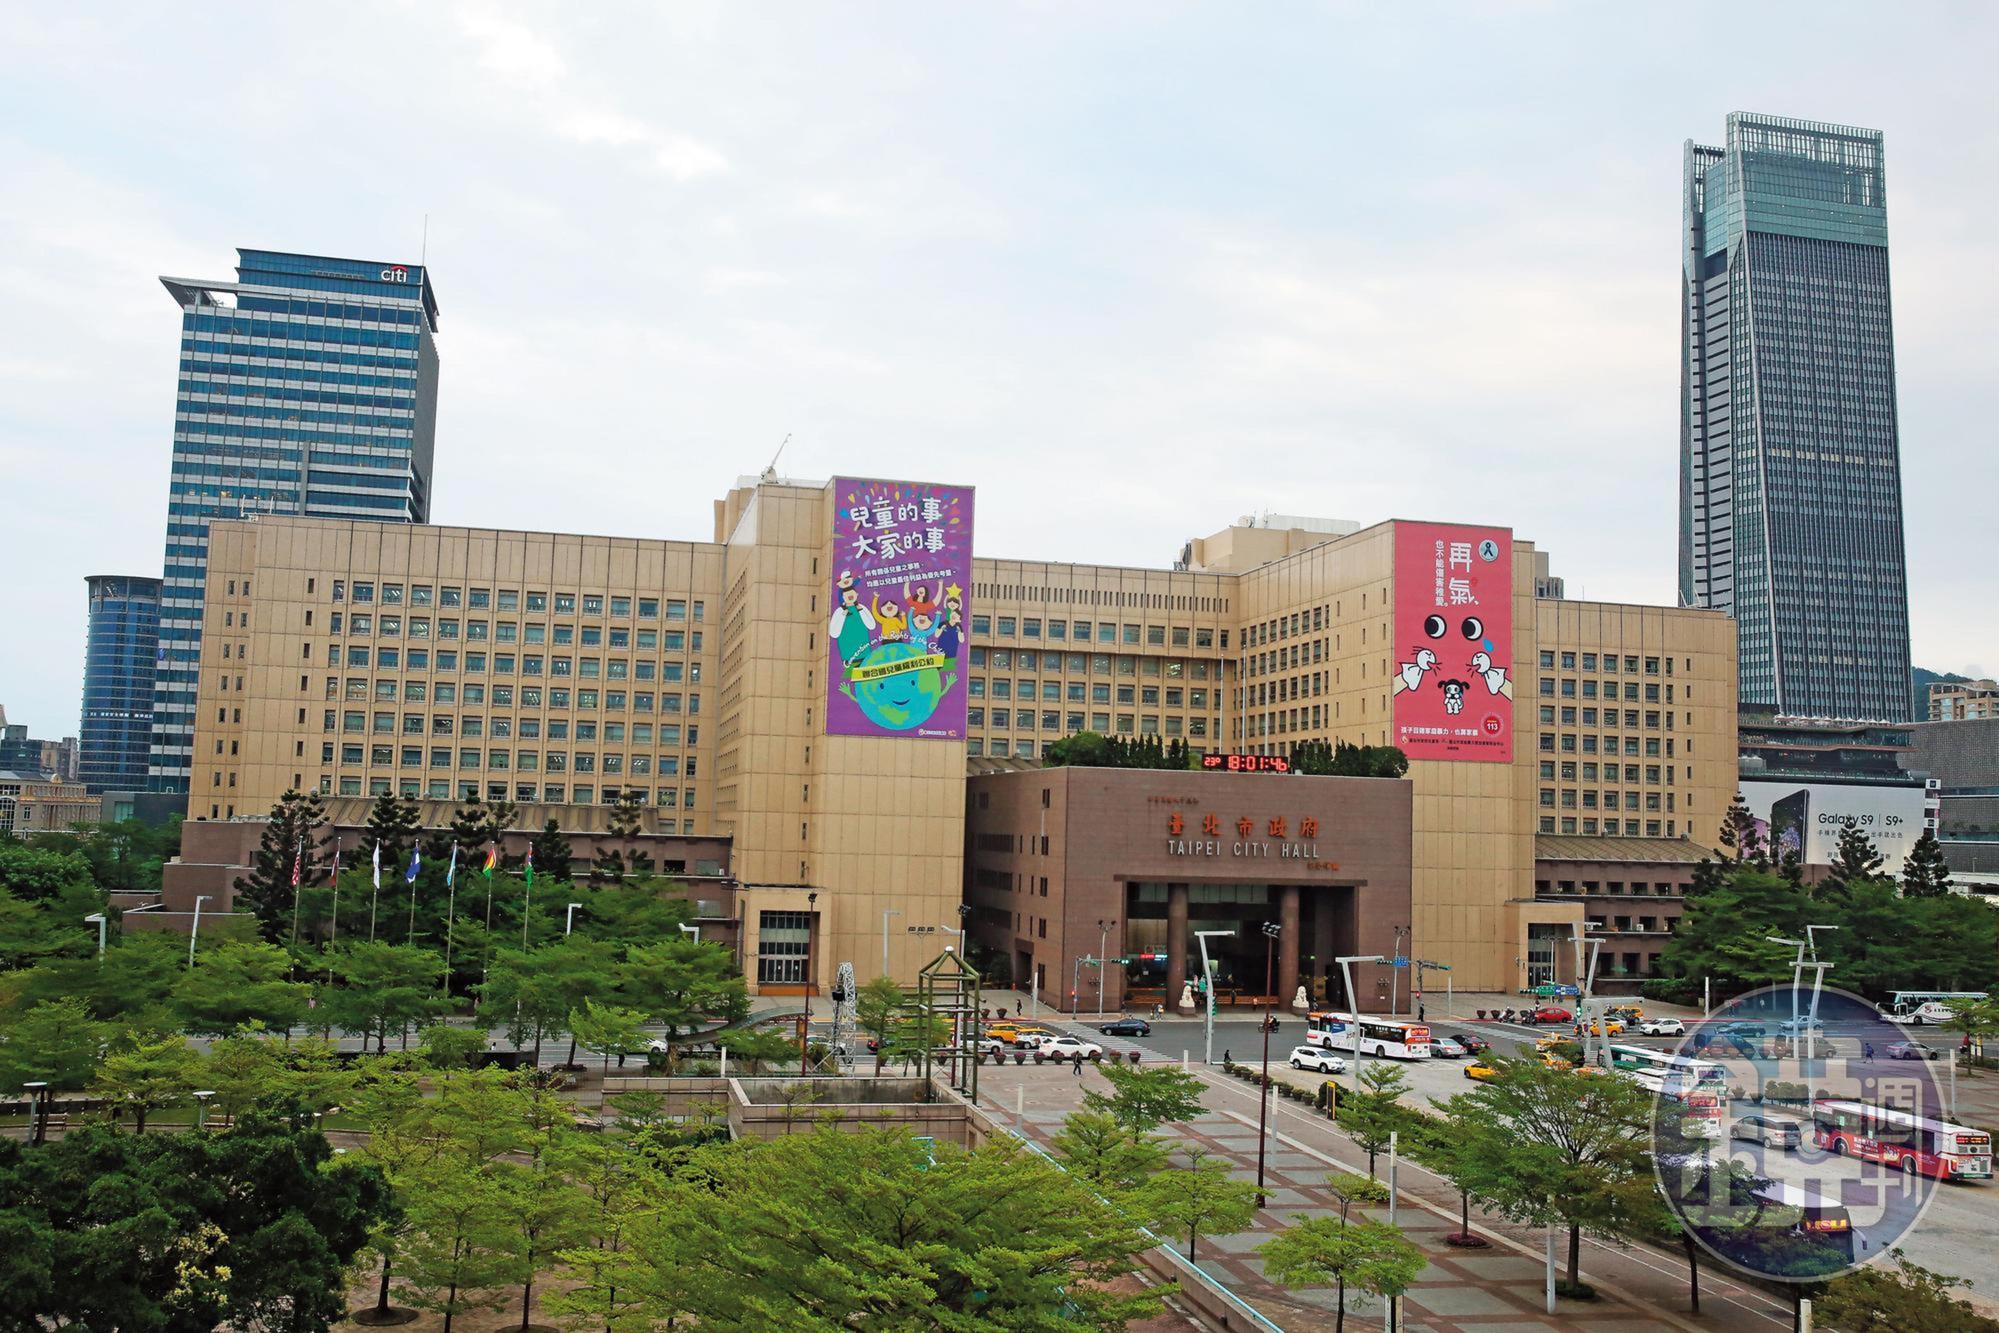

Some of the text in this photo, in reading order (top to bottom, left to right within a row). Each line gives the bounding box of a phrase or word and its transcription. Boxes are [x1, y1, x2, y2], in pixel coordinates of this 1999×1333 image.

[381, 268, 407, 283] citi
[850, 496, 943, 530] 兒童的事
[852, 526, 946, 559] 大家的事
[1487, 722, 1498, 731] 113
[1228, 755, 1288, 771] 18:01:46
[1168, 811, 1320, 838] 臺北市政府
[1818, 813, 1903, 826] Galaxy S9 S9+
[1168, 840, 1320, 858] TAIPEI CITY HALL
